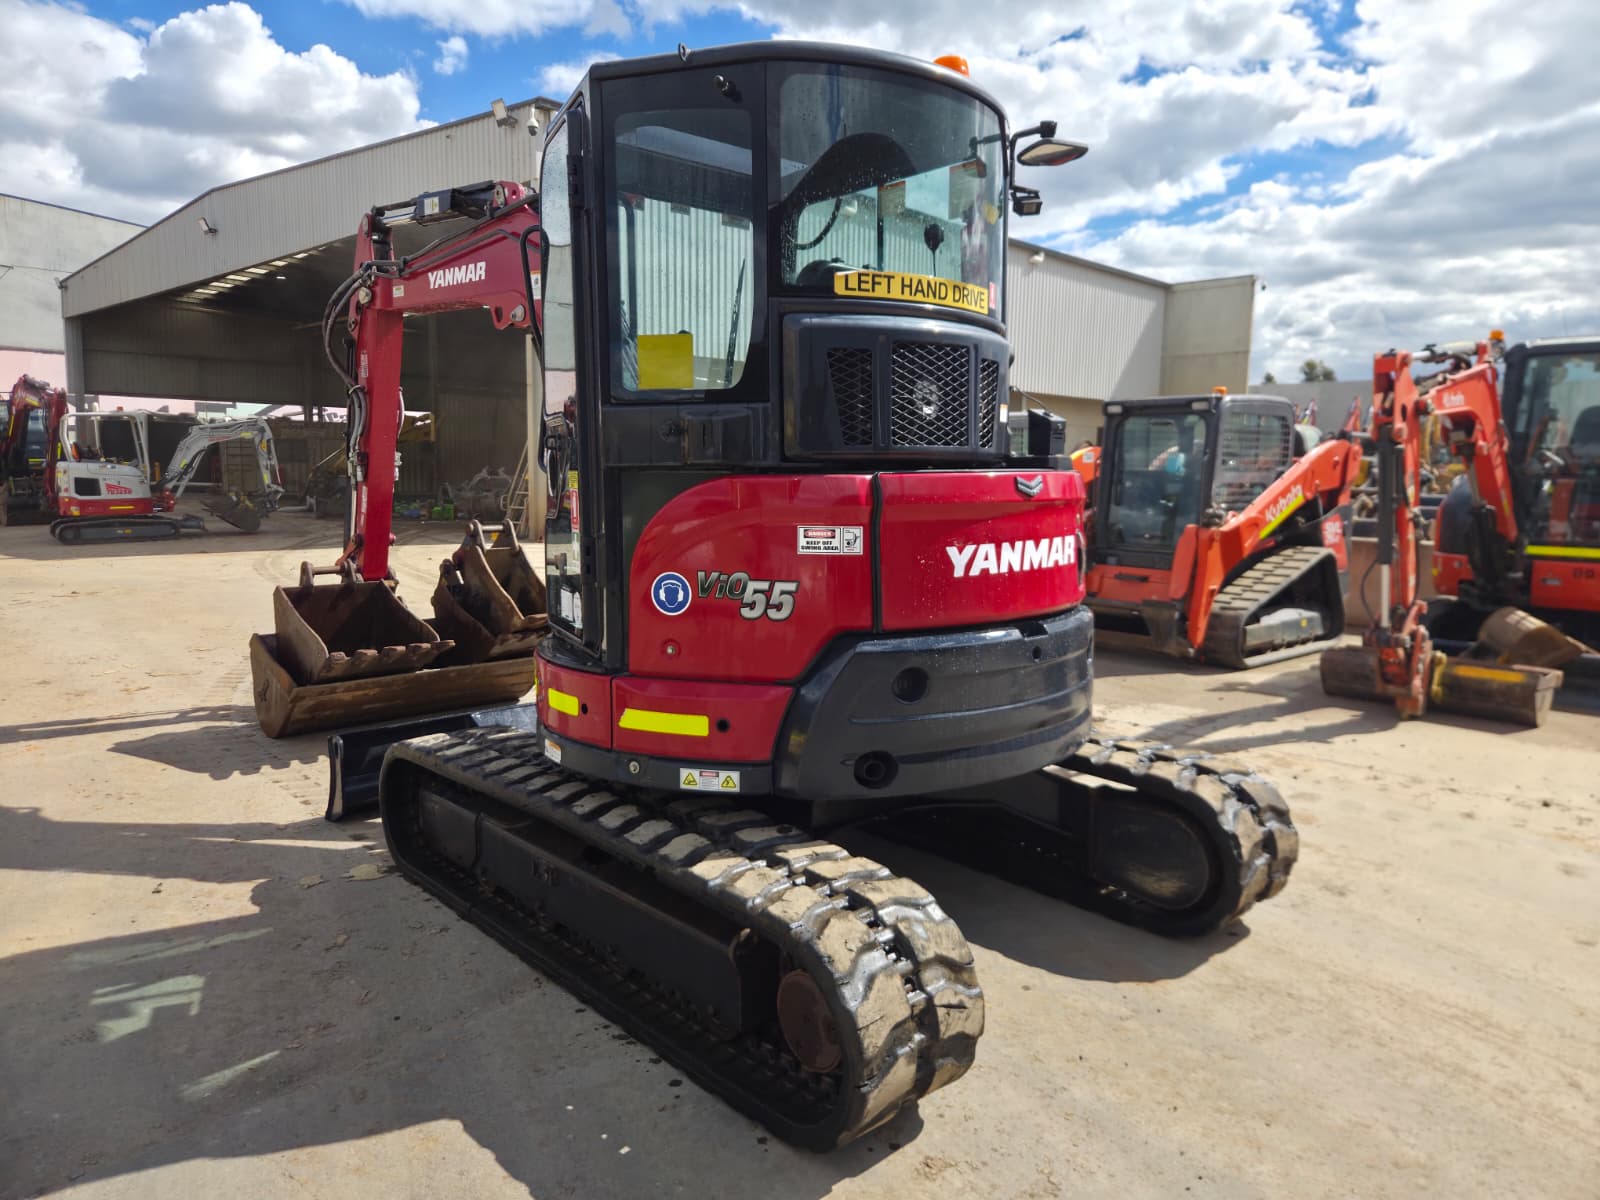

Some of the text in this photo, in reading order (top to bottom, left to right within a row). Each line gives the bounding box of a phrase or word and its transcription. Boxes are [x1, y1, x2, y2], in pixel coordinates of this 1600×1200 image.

[428, 261, 487, 289] YANMAR
[844, 272, 985, 310] LEFT HAND DRIVE
[945, 535, 1075, 578] YANMAR
